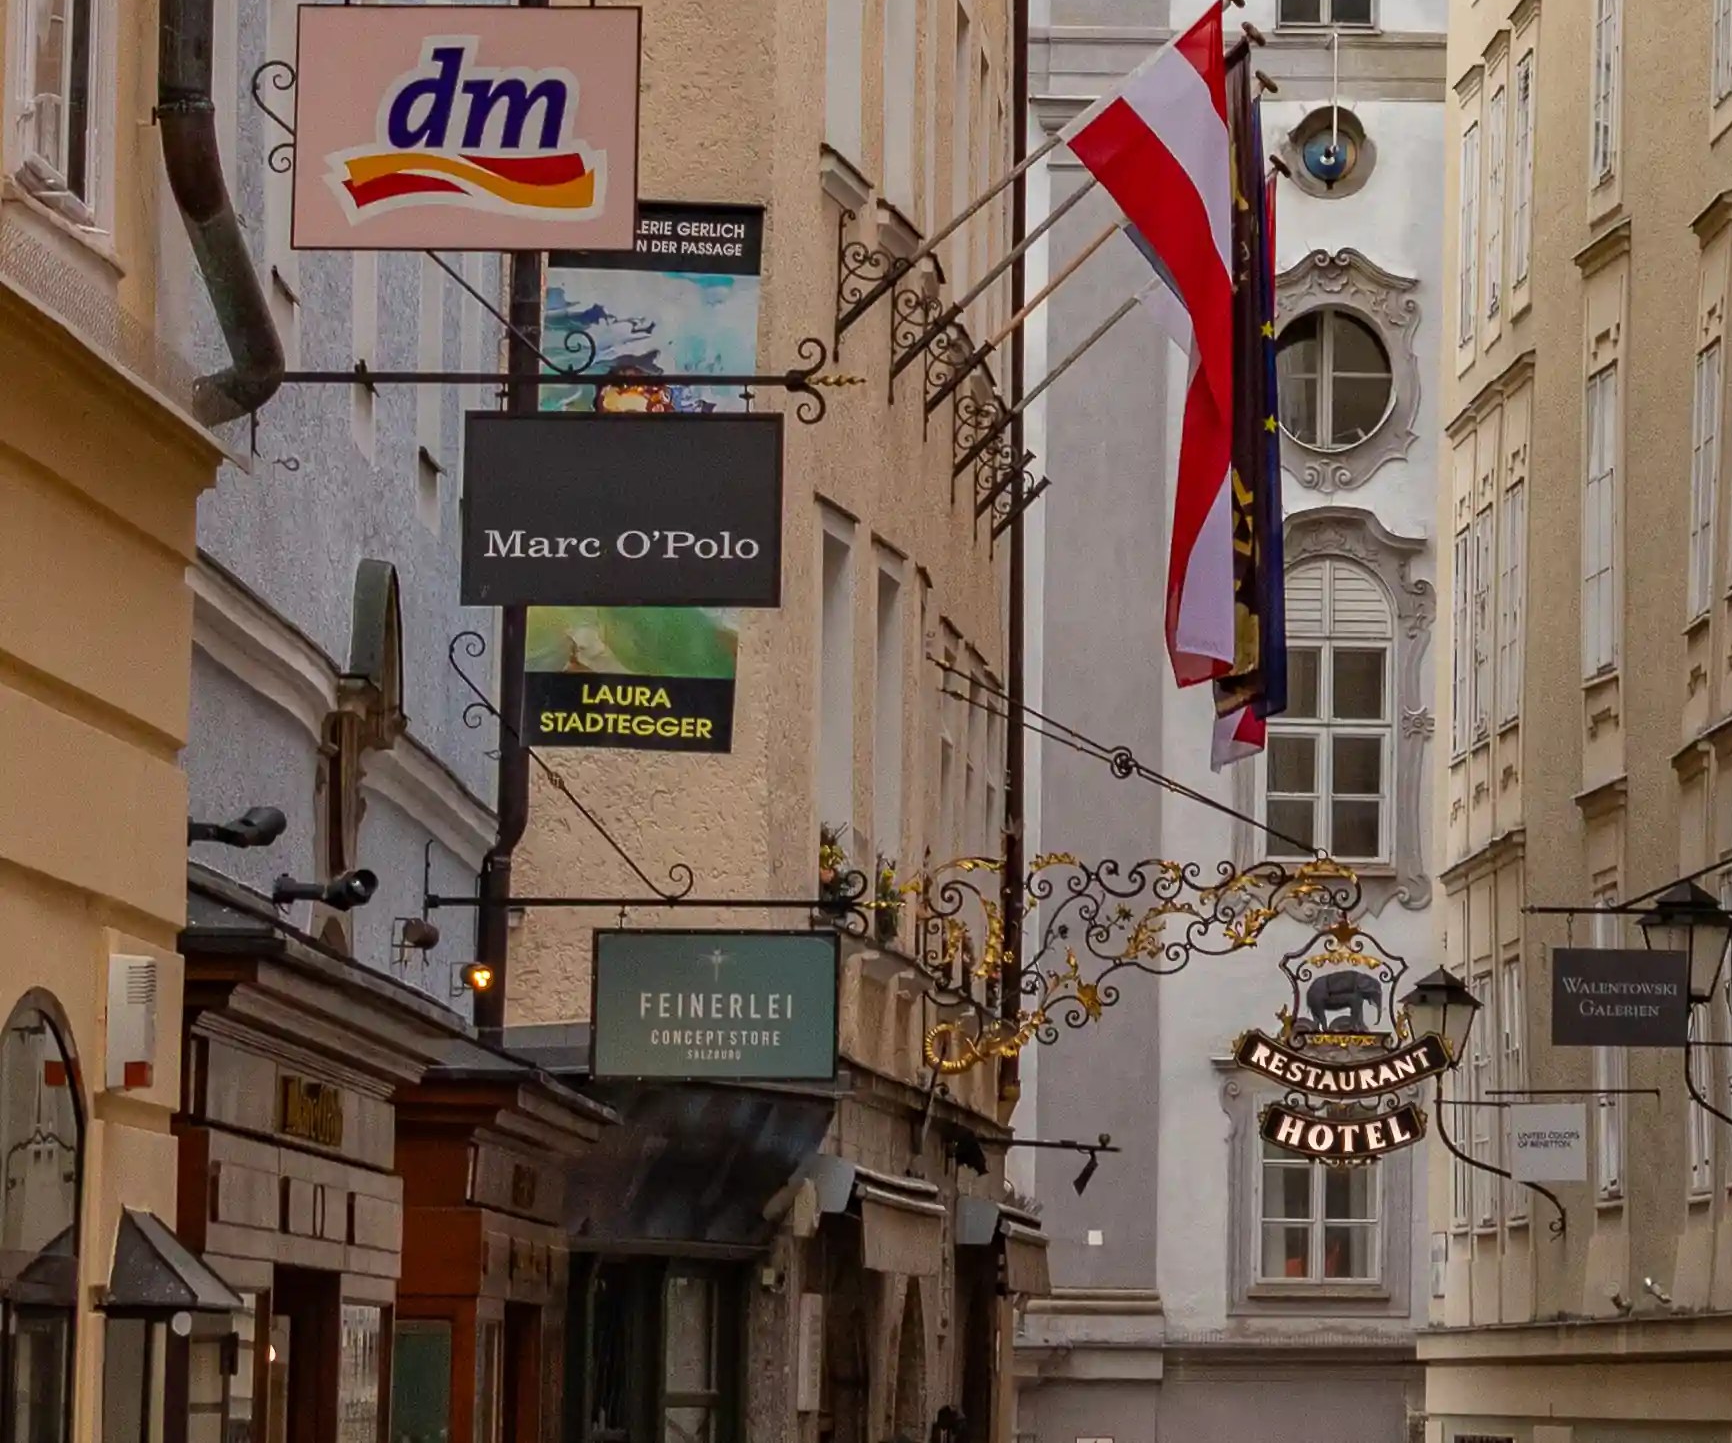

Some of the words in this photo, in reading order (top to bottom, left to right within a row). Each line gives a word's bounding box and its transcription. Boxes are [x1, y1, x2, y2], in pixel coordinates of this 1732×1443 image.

[388, 47, 567, 149] dm
[677, 222, 745, 239] GERLICH
[651, 240, 677, 254] DER
[681, 242, 743, 257] PASSAGE
[483, 529, 600, 558] Marc
[616, 530, 760, 560] O'Polo
[581, 684, 672, 709] LAURA
[540, 711, 713, 740] STADTEGGER
[640, 992, 793, 1020] FEINERLEI
[651, 1028, 724, 1046] CONCEPT
[729, 1029, 781, 1047] STORE
[686, 1048, 742, 1061] SALZBURG
[1251, 1042, 1431, 1092] RESTAURANT
[1276, 1114, 1412, 1153] HOTEL
